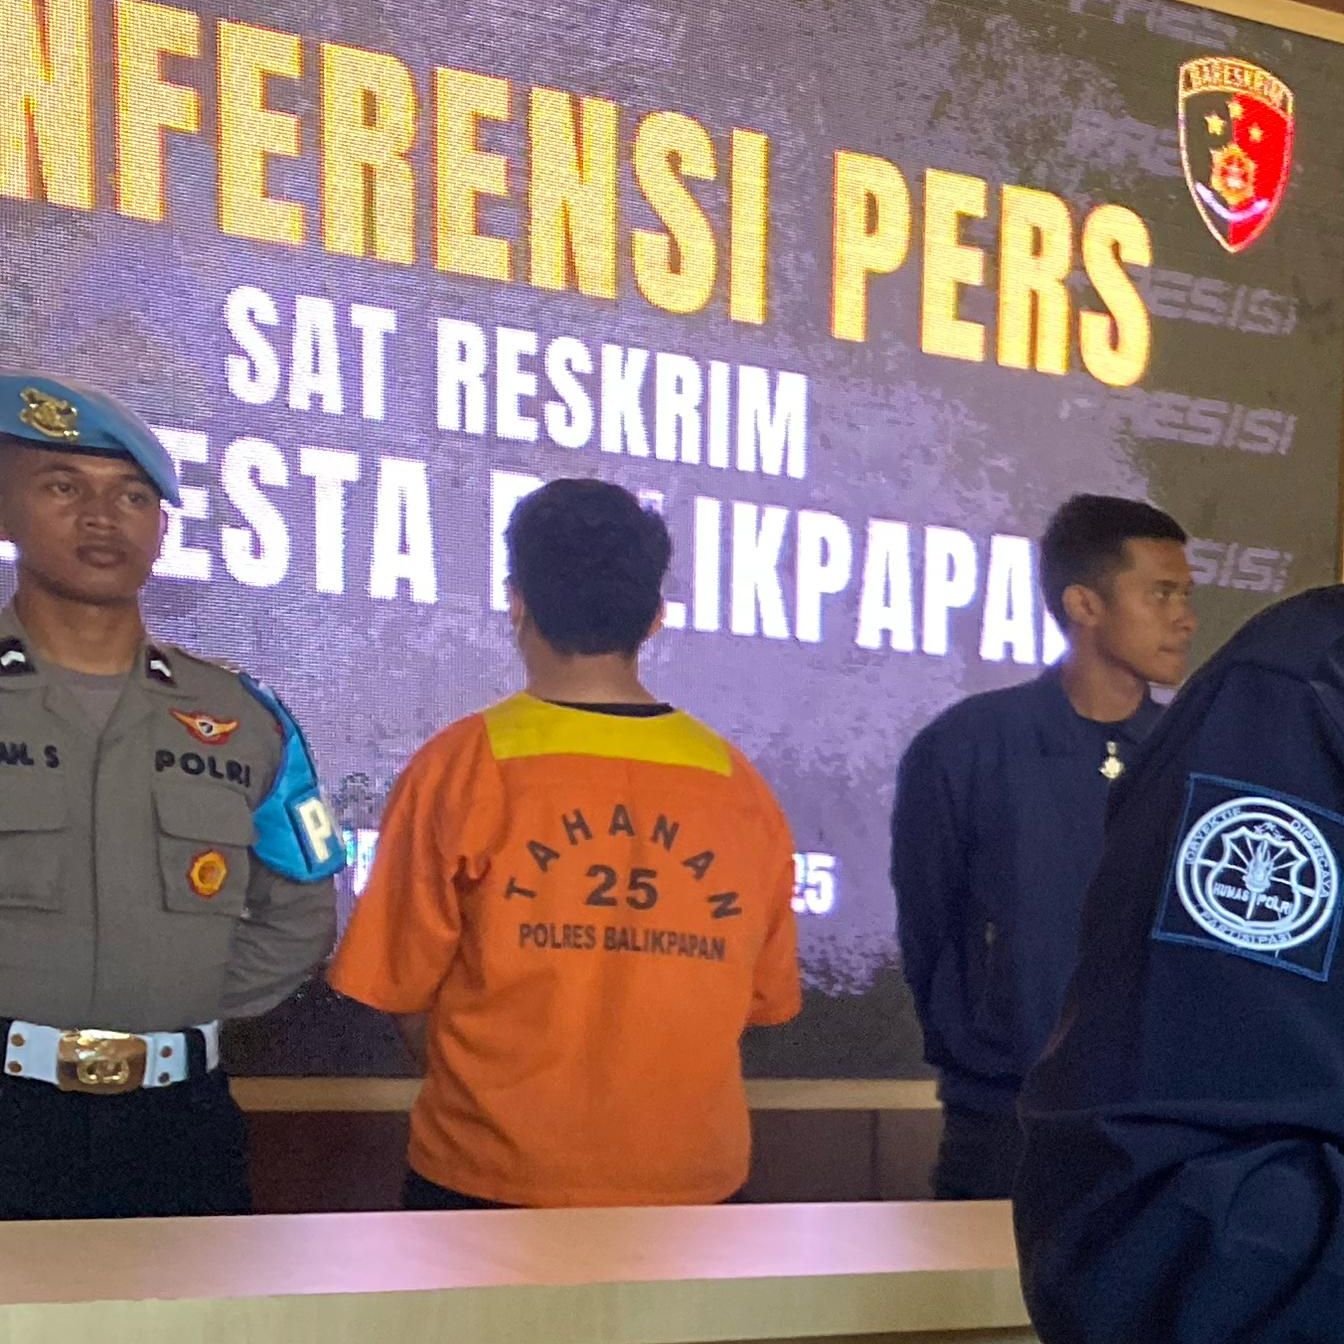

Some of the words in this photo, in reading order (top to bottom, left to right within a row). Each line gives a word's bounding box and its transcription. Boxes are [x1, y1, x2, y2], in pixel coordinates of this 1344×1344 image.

[829, 148, 1152, 387] PERS
[224, 284, 397, 421] SAT
[435, 318, 809, 480] RESKRIM
[0, 424, 438, 602] ESTA
[490, 468, 1067, 664] IKPAPA
[44, 745, 60, 768] S
[155, 750, 251, 787] POLRI
[504, 804, 743, 920] TAHANAN
[585, 864, 658, 910] 25
[1213, 881, 1251, 902] HUMAS
[1256, 895, 1293, 916] POLRI
[519, 923, 597, 951] POLRES
[603, 926, 726, 962] BALIKPAPAN
